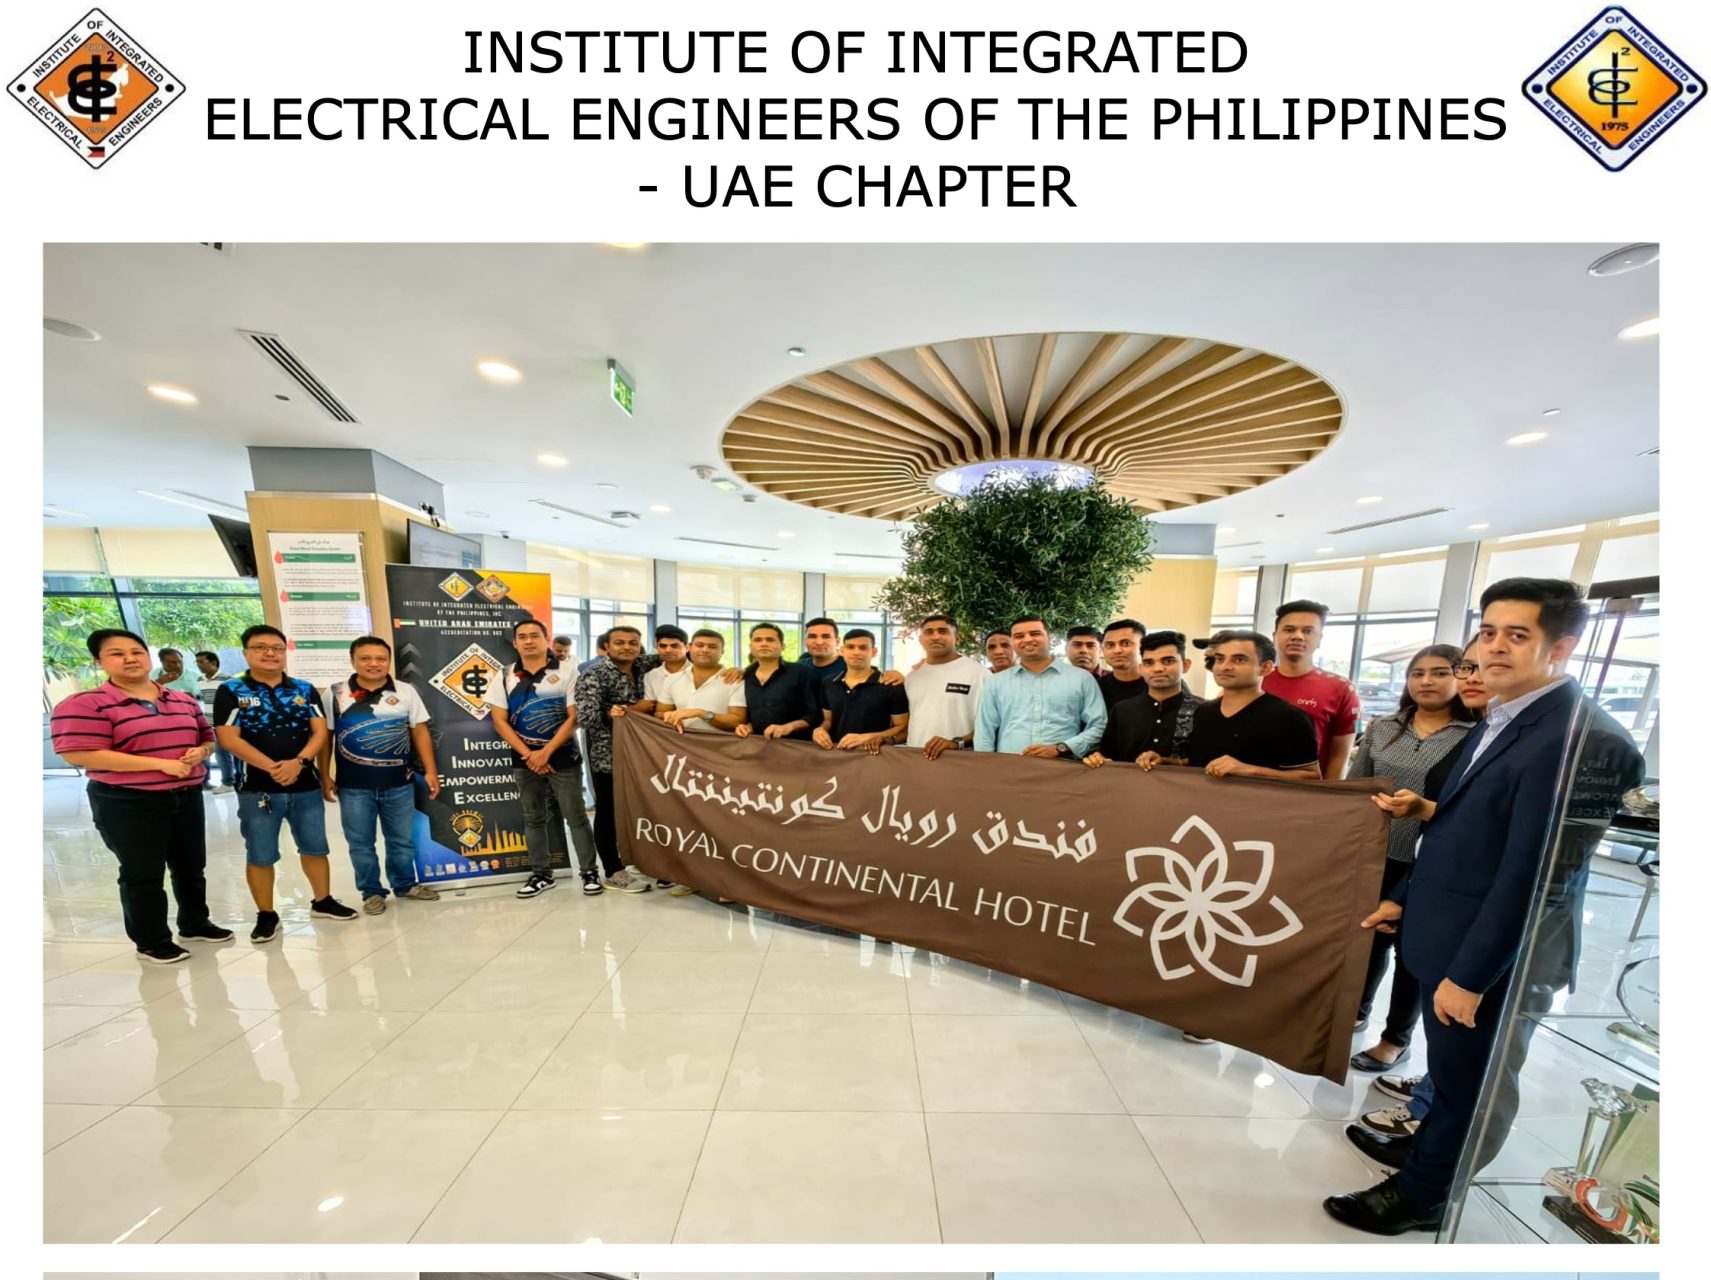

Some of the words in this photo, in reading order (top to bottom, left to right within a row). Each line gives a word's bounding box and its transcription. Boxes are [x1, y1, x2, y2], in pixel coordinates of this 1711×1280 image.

[441, 653, 469, 677] INSTITUTE
[440, 685, 473, 712] ELECTRICAL
[463, 738, 512, 751] INTEGR
[650, 753, 846, 825] كونتيننتال
[861, 784, 958, 848] رويال
[972, 810, 1098, 863] فندق
[636, 817, 725, 860] ROYAL
[731, 844, 960, 912] CONTINENTAL
[973, 887, 1097, 946] HOTEL
